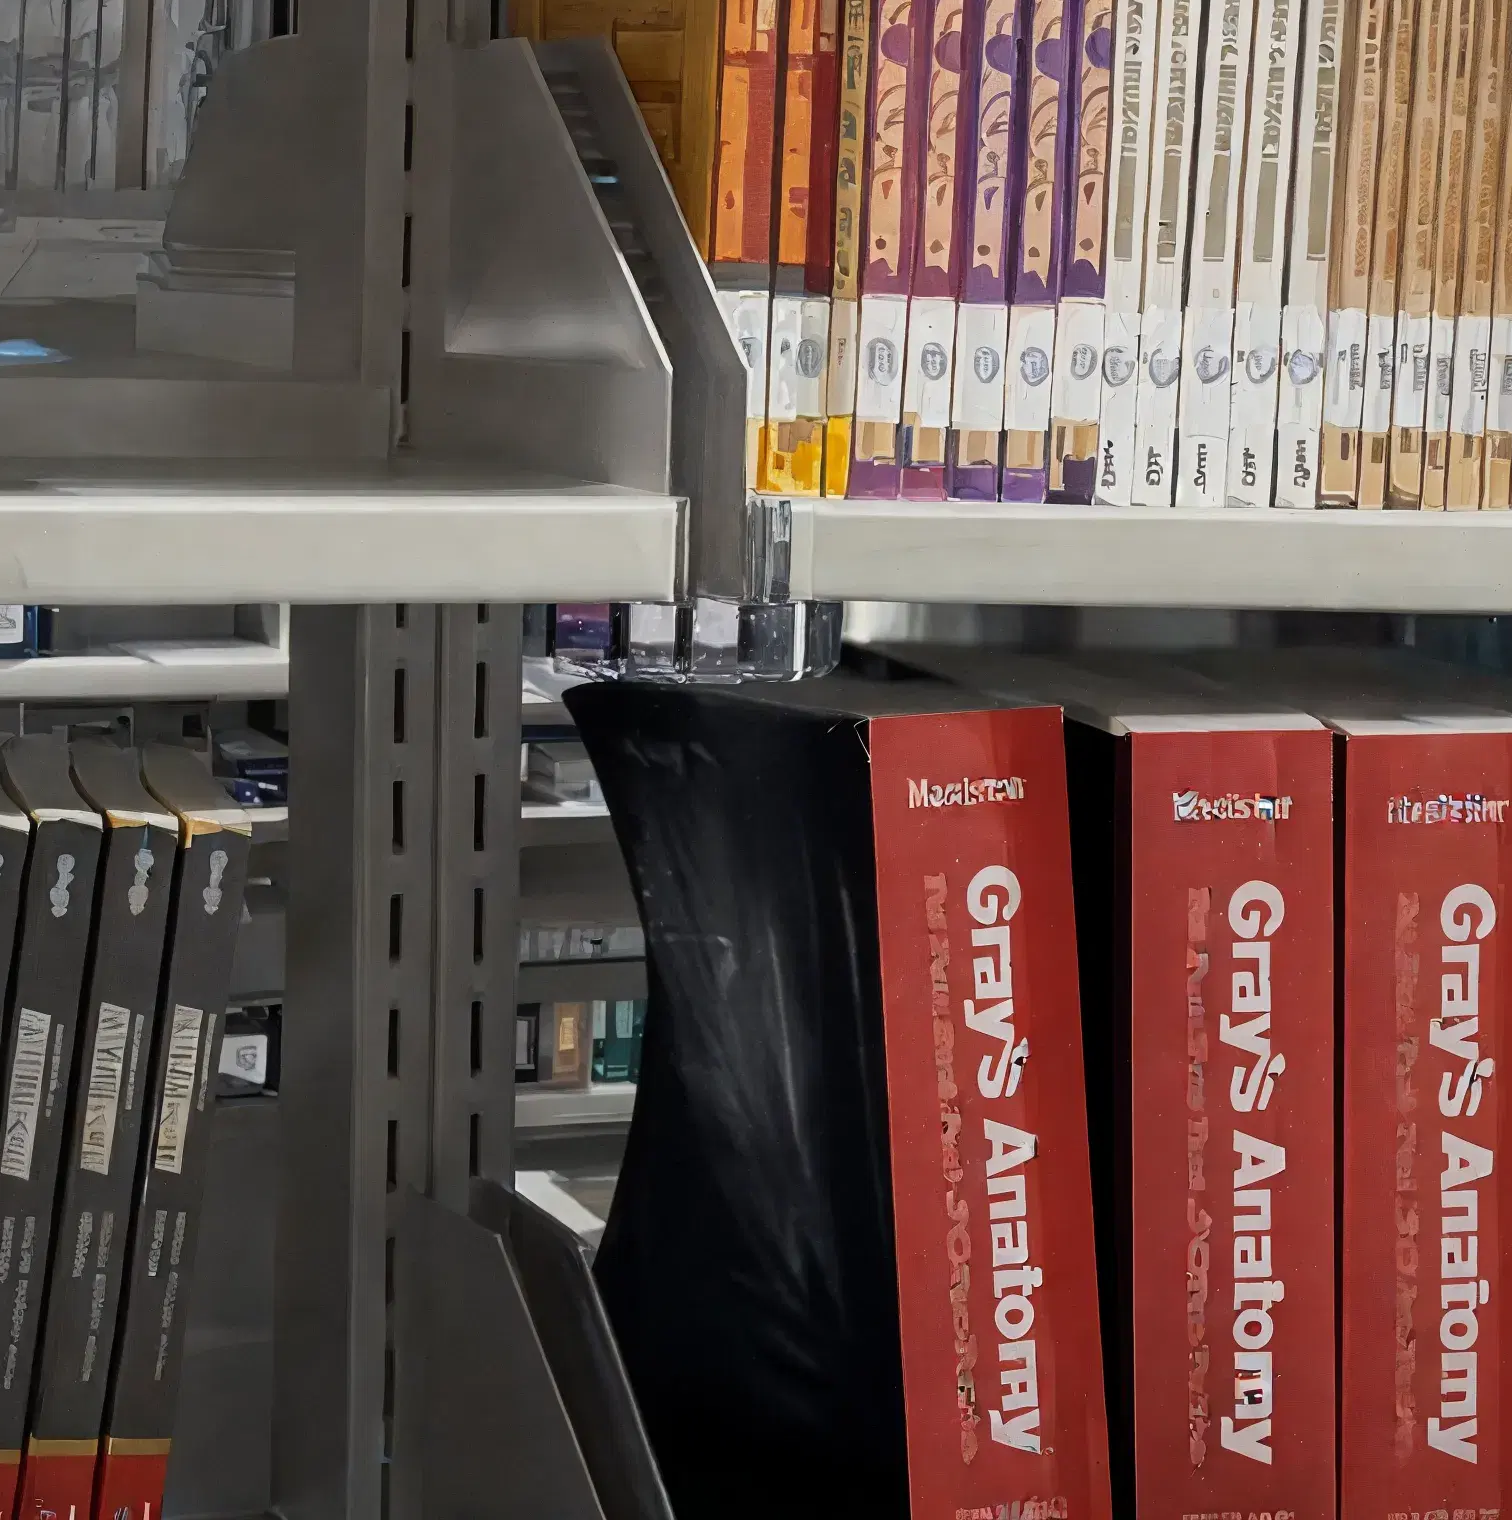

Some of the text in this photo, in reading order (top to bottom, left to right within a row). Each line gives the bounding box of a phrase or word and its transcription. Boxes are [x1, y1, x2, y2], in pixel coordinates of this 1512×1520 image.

[964, 865, 1029, 1099] Gray's
[1220, 880, 1285, 1113] Gray's
[1430, 884, 1497, 1117] Gray's
[984, 1119, 1043, 1455] Anatomy
[1221, 1130, 1285, 1465] Anatomy
[1427, 1132, 1494, 1464] Anatomy
